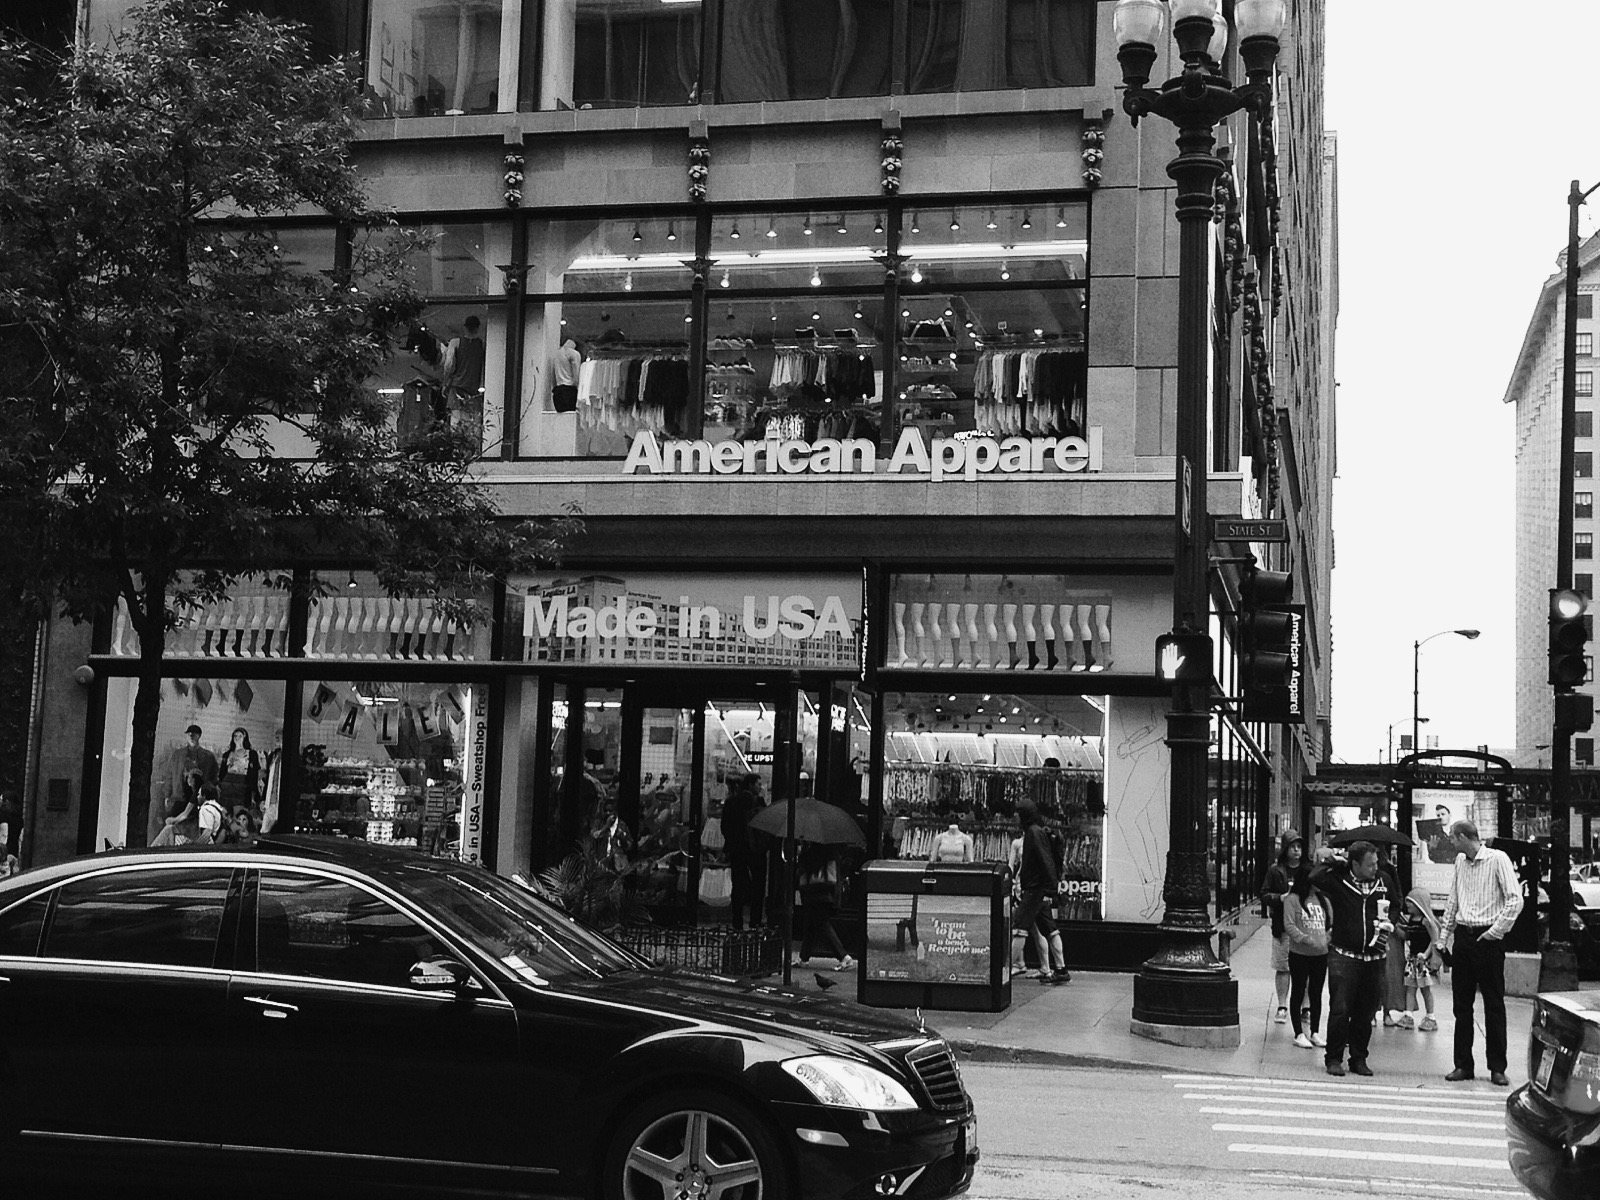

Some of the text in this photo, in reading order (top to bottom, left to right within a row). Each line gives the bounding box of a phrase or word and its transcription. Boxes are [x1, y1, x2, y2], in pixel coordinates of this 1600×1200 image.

[622, 424, 1103, 482] American Apparel
[1229, 525, 1254, 536] STATE
[522, 595, 855, 640] Made in USA
[1288, 612, 1302, 715] American Apparel
[468, 837, 479, 849] in
[474, 688, 487, 718] Free
[928, 943, 970, 955] Recycle
[936, 926, 966, 940] to be
